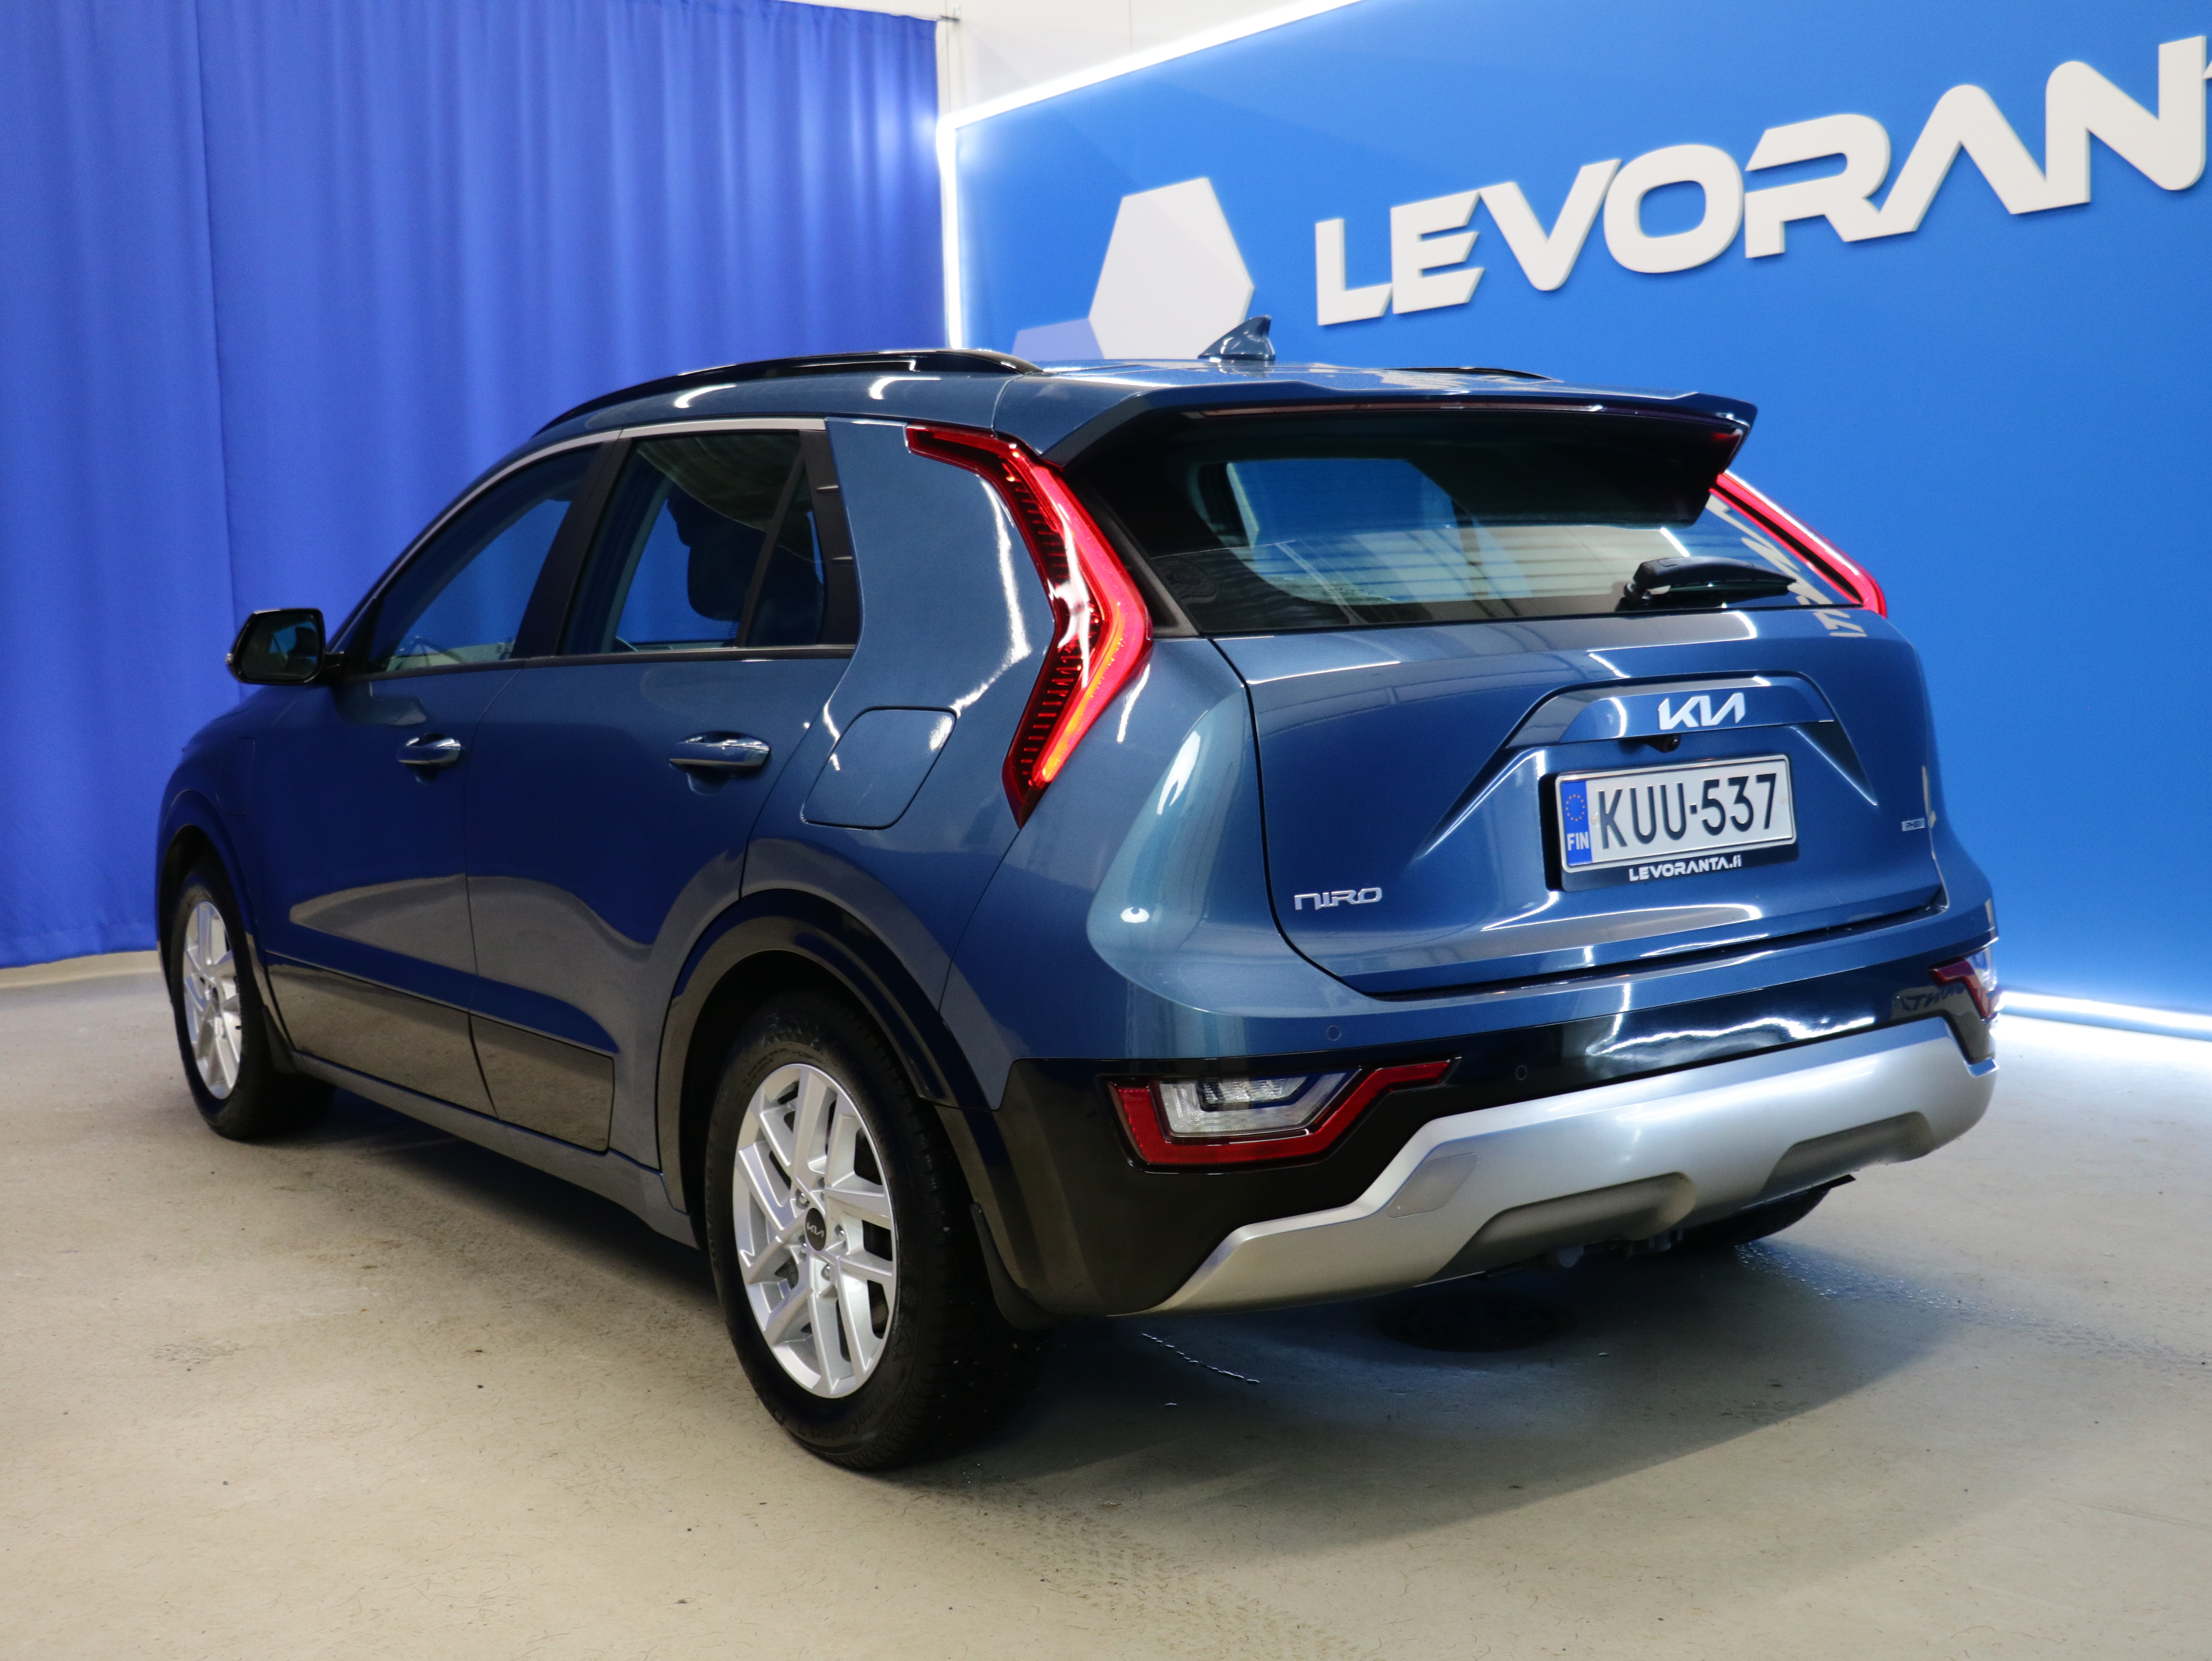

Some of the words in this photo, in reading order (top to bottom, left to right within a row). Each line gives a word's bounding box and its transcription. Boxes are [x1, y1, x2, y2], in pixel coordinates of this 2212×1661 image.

[1314, 35, 2212, 326] LEVORAN
[1657, 692, 1746, 730] KIA
[1598, 772, 1777, 850] KUU-537
[1566, 831, 1589, 851] FIN
[1629, 855, 1742, 882] LEVORANTA.fi
[1294, 887, 1382, 910] NIRO
